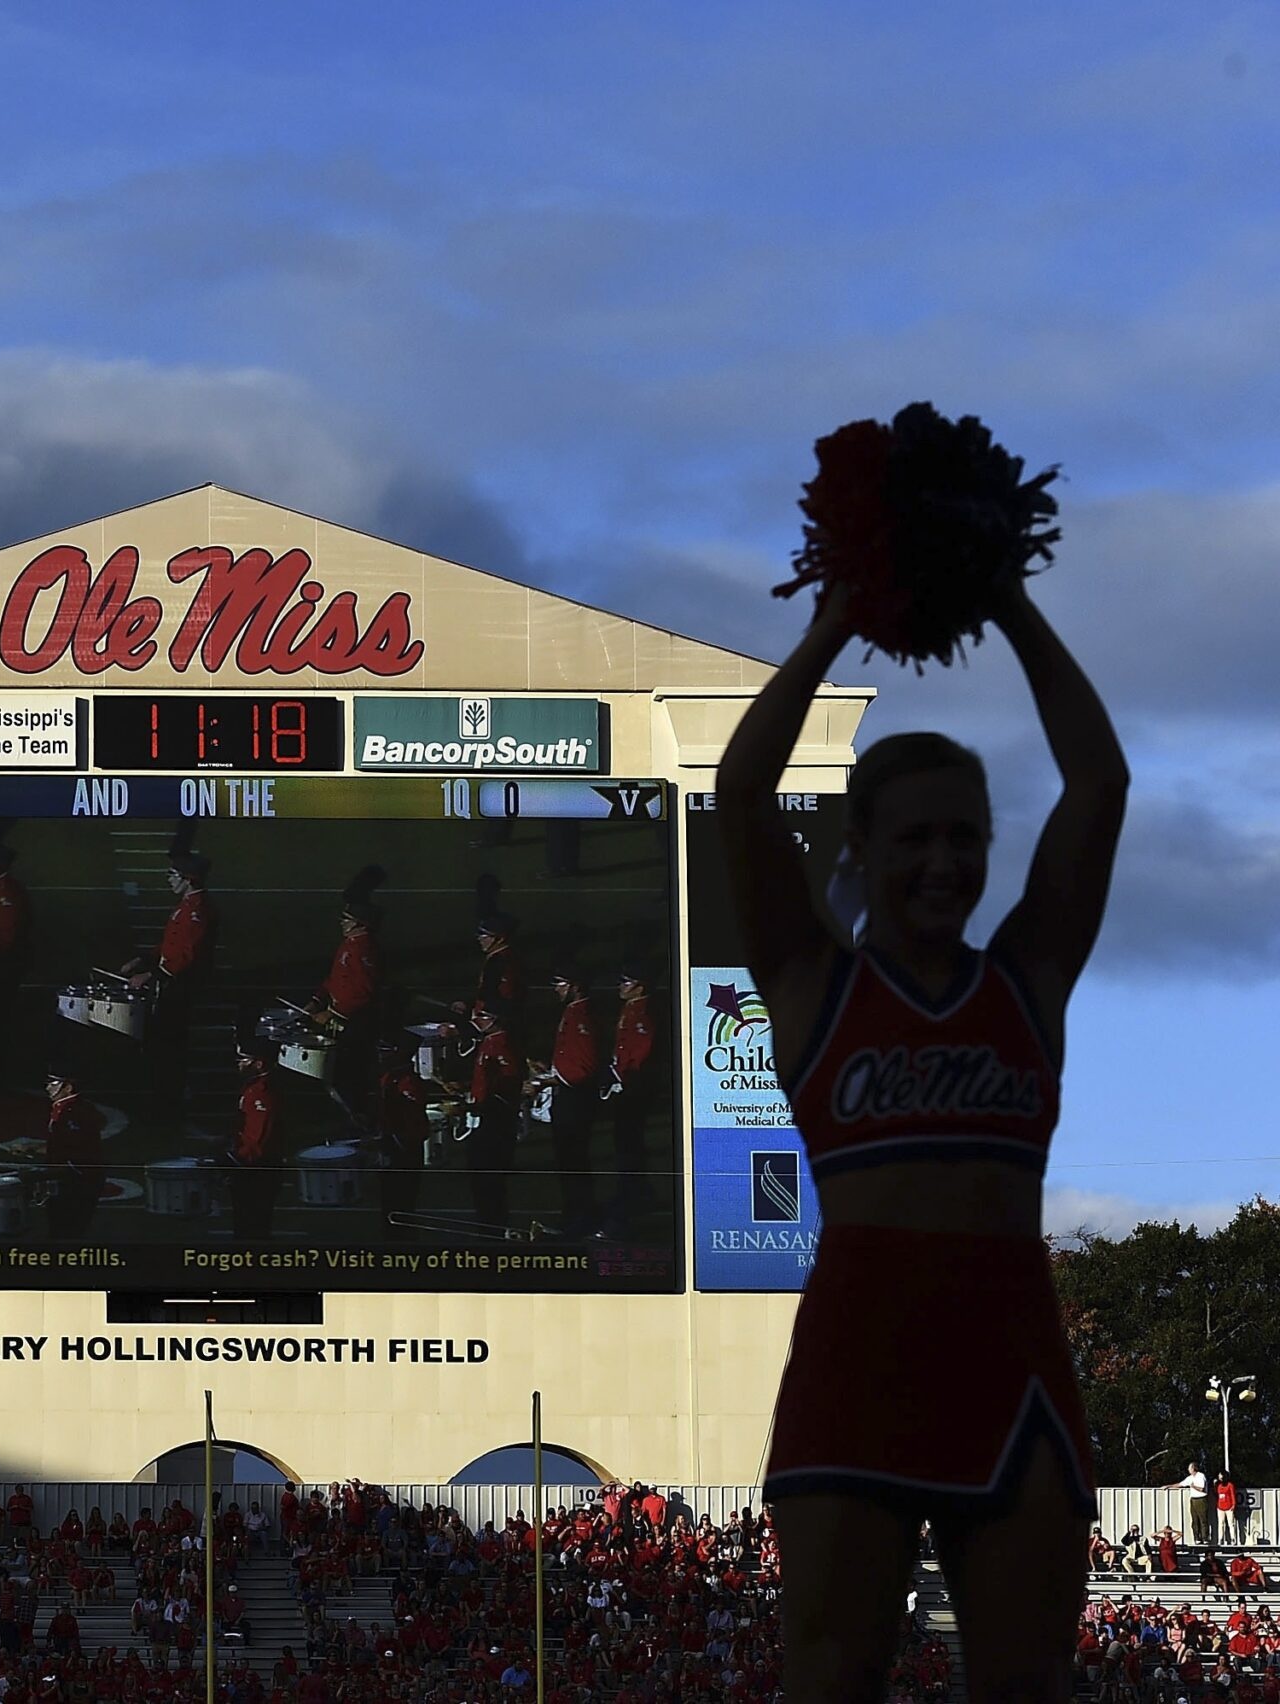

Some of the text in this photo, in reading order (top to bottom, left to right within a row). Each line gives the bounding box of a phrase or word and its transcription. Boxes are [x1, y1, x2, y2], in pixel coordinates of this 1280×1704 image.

[167, 546, 425, 677] Miss
[18, 736, 68, 754] Team
[361, 735, 589, 769] BancorpSouth
[72, 778, 276, 817] AND ON THE
[440, 779, 471, 819] 1Q
[504, 781, 519, 818] 0
[618, 789, 640, 816] V
[719, 1074, 738, 1090] of
[713, 1102, 765, 1115] University
[766, 1102, 777, 1113] of
[735, 1116, 775, 1126] Medical
[8, 1247, 51, 1266] free
[58, 1247, 127, 1266] refills.
[182, 1249, 254, 1272] Forgot
[259, 1249, 320, 1268] cash?
[324, 1249, 376, 1268] Visit
[381, 1255, 420, 1273] any
[426, 1250, 450, 1269] of
[454, 1250, 490, 1269] the
[60, 1336, 375, 1363] HOLLINGSWORTH
[388, 1338, 490, 1364] FIELD
